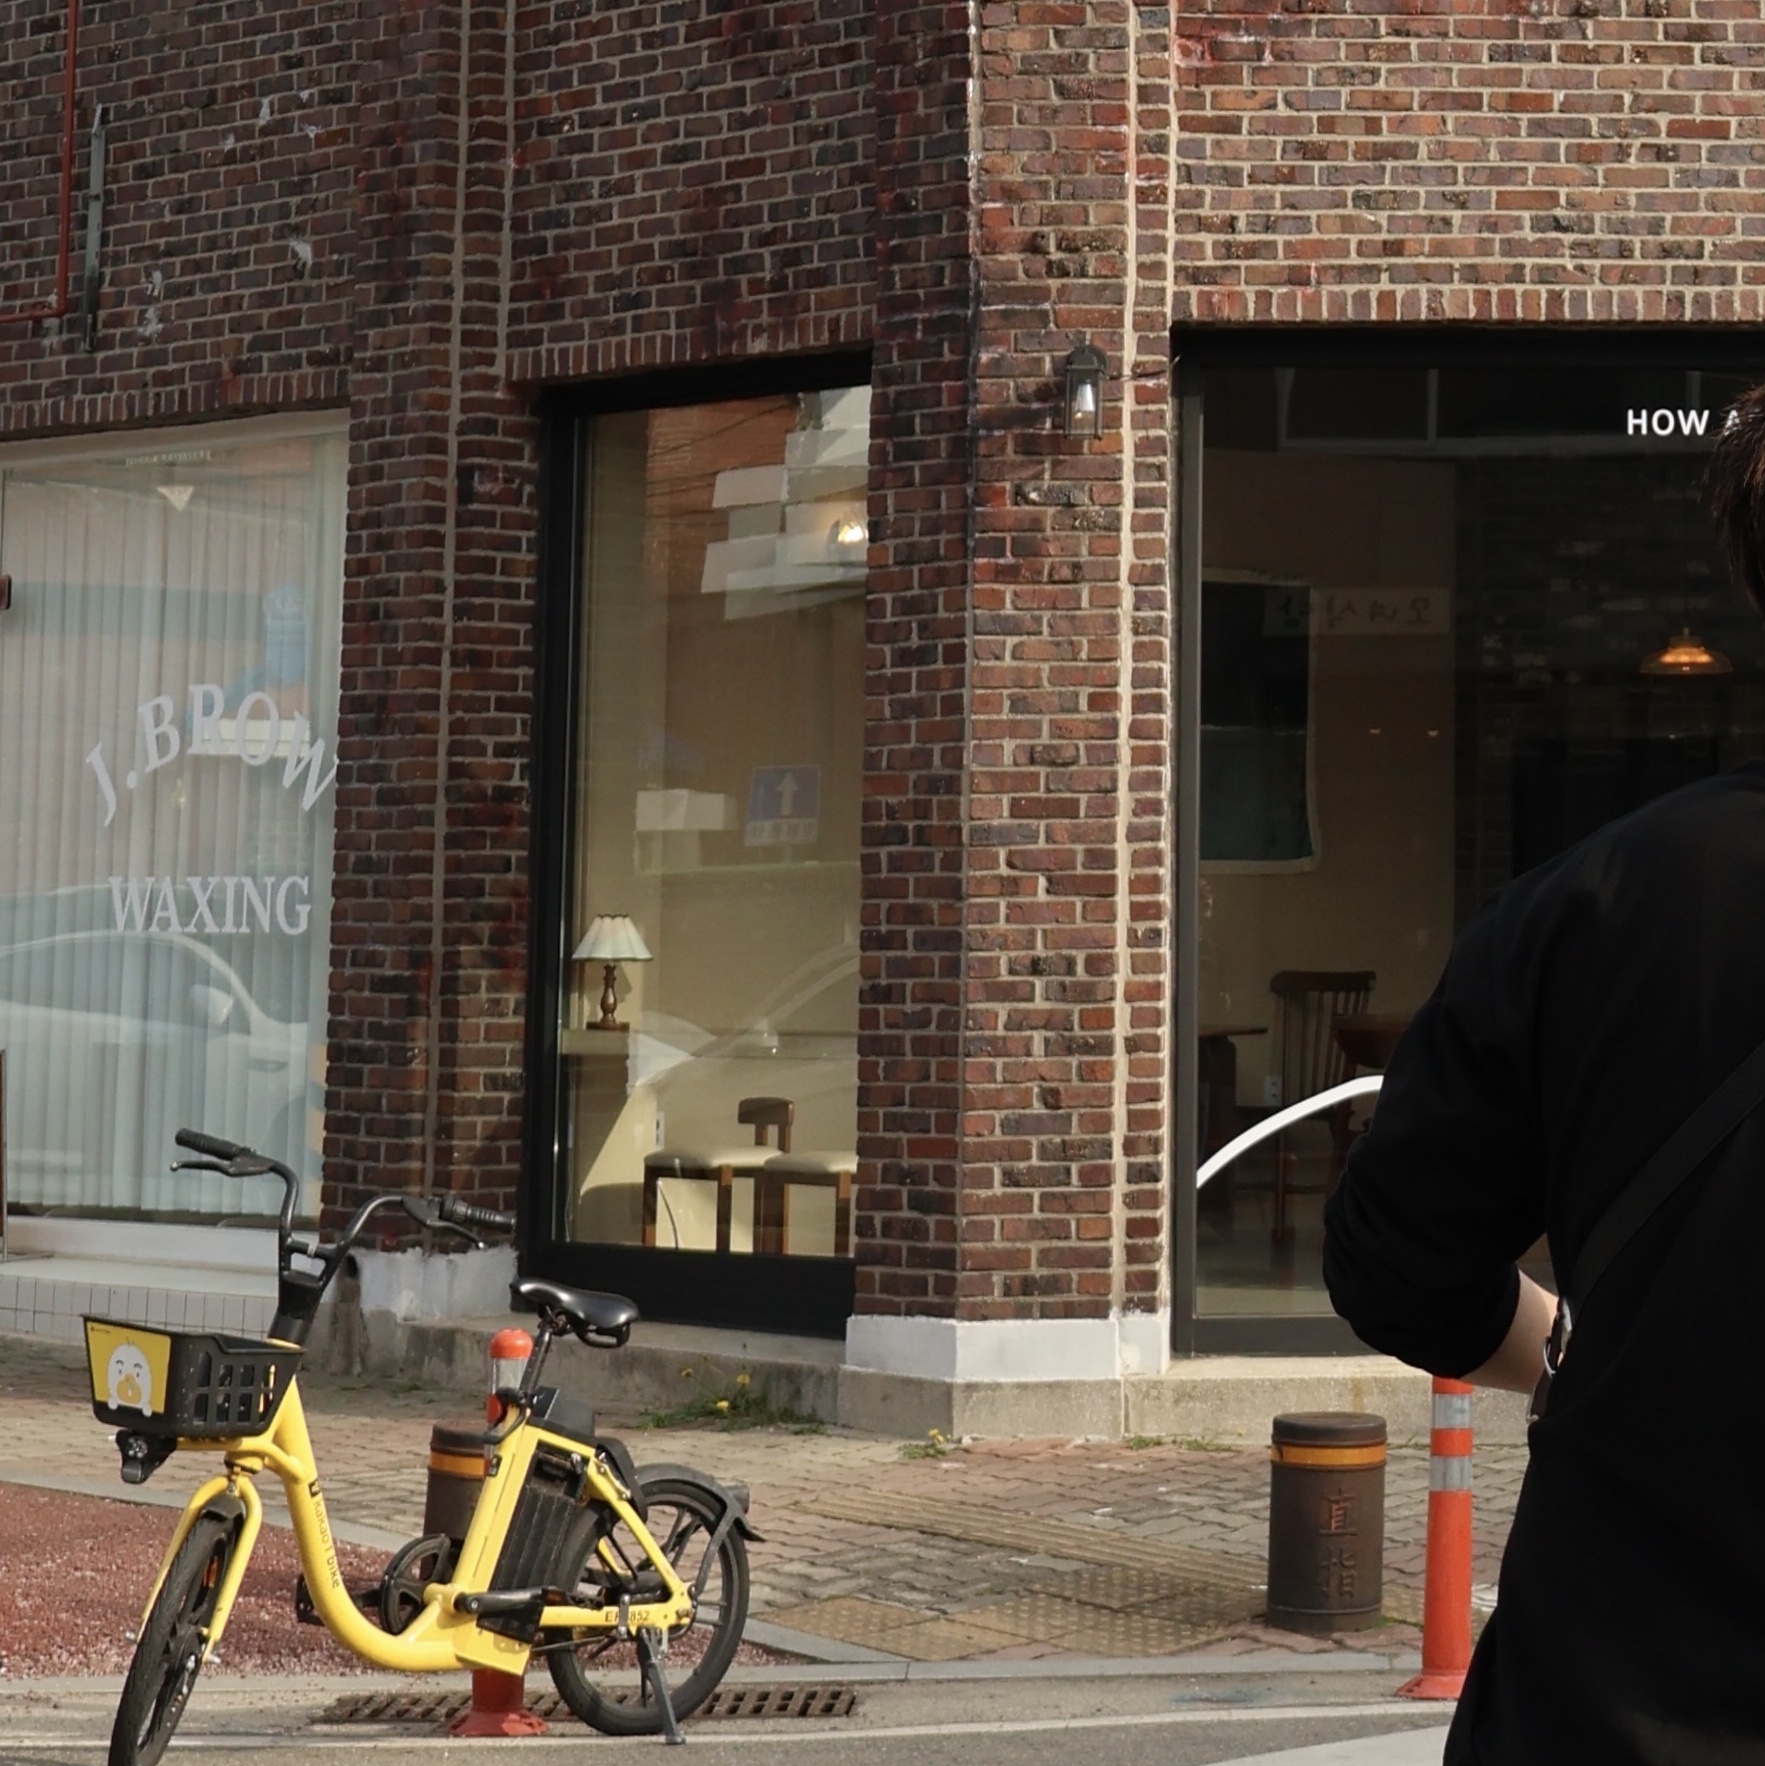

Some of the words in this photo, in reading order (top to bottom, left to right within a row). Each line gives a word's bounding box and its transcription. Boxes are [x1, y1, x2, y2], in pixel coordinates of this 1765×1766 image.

[1626, 408, 1709, 435] HOW
[108, 875, 311, 935] WAXING
[326, 1555, 340, 1589] bike
